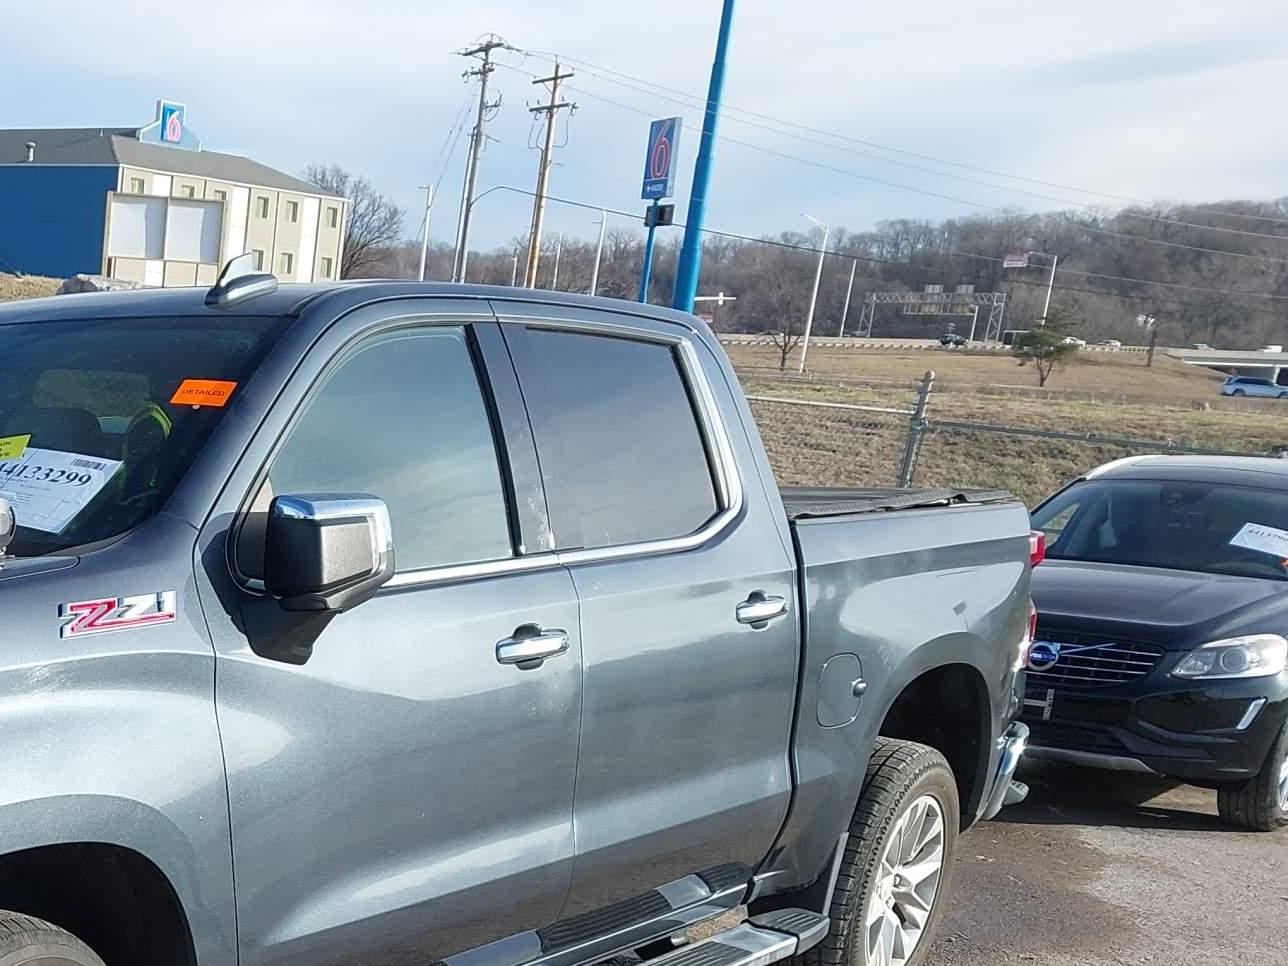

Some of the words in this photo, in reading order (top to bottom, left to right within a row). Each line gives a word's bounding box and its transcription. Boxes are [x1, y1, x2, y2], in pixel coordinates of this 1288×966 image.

[167, 110, 181, 141] 6
[651, 120, 670, 178] 6
[182, 388, 226, 397] DETAILED
[58, 590, 176, 639] Z71
